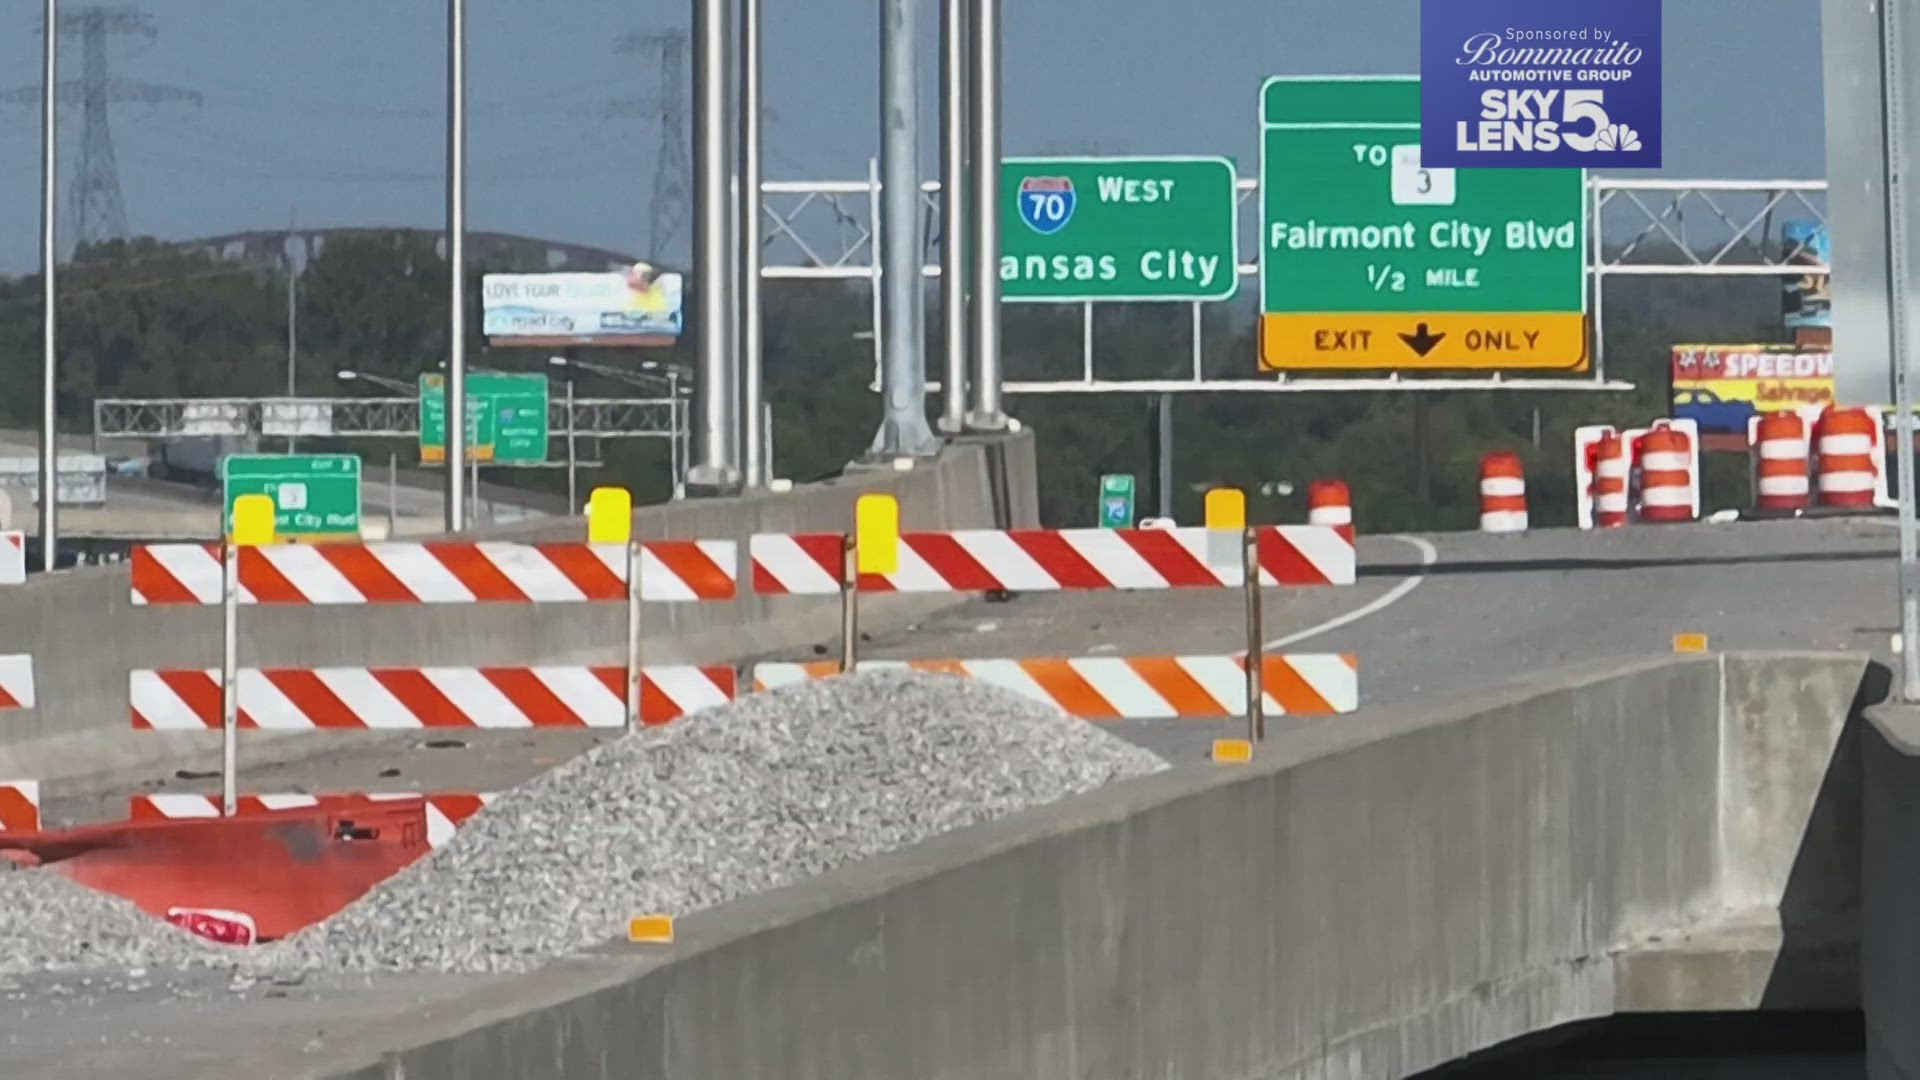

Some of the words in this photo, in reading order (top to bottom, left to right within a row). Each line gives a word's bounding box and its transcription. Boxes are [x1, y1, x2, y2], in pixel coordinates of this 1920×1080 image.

[1353, 144, 1388, 166] TO
[1416, 169, 1433, 195] 3
[1028, 193, 1066, 221] 70
[1097, 175, 1175, 203] WEST
[1270, 219, 1415, 250] Fairmont
[1430, 220, 1492, 256] City
[1505, 219, 1575, 249] Blvd
[1000, 254, 1117, 281] ansas
[1140, 248, 1219, 288] City
[1367, 264, 1406, 292] 1/2
[1425, 268, 1480, 287] MILE
[1314, 329, 1372, 351] EXIT
[1465, 329, 1541, 351] ONLY
